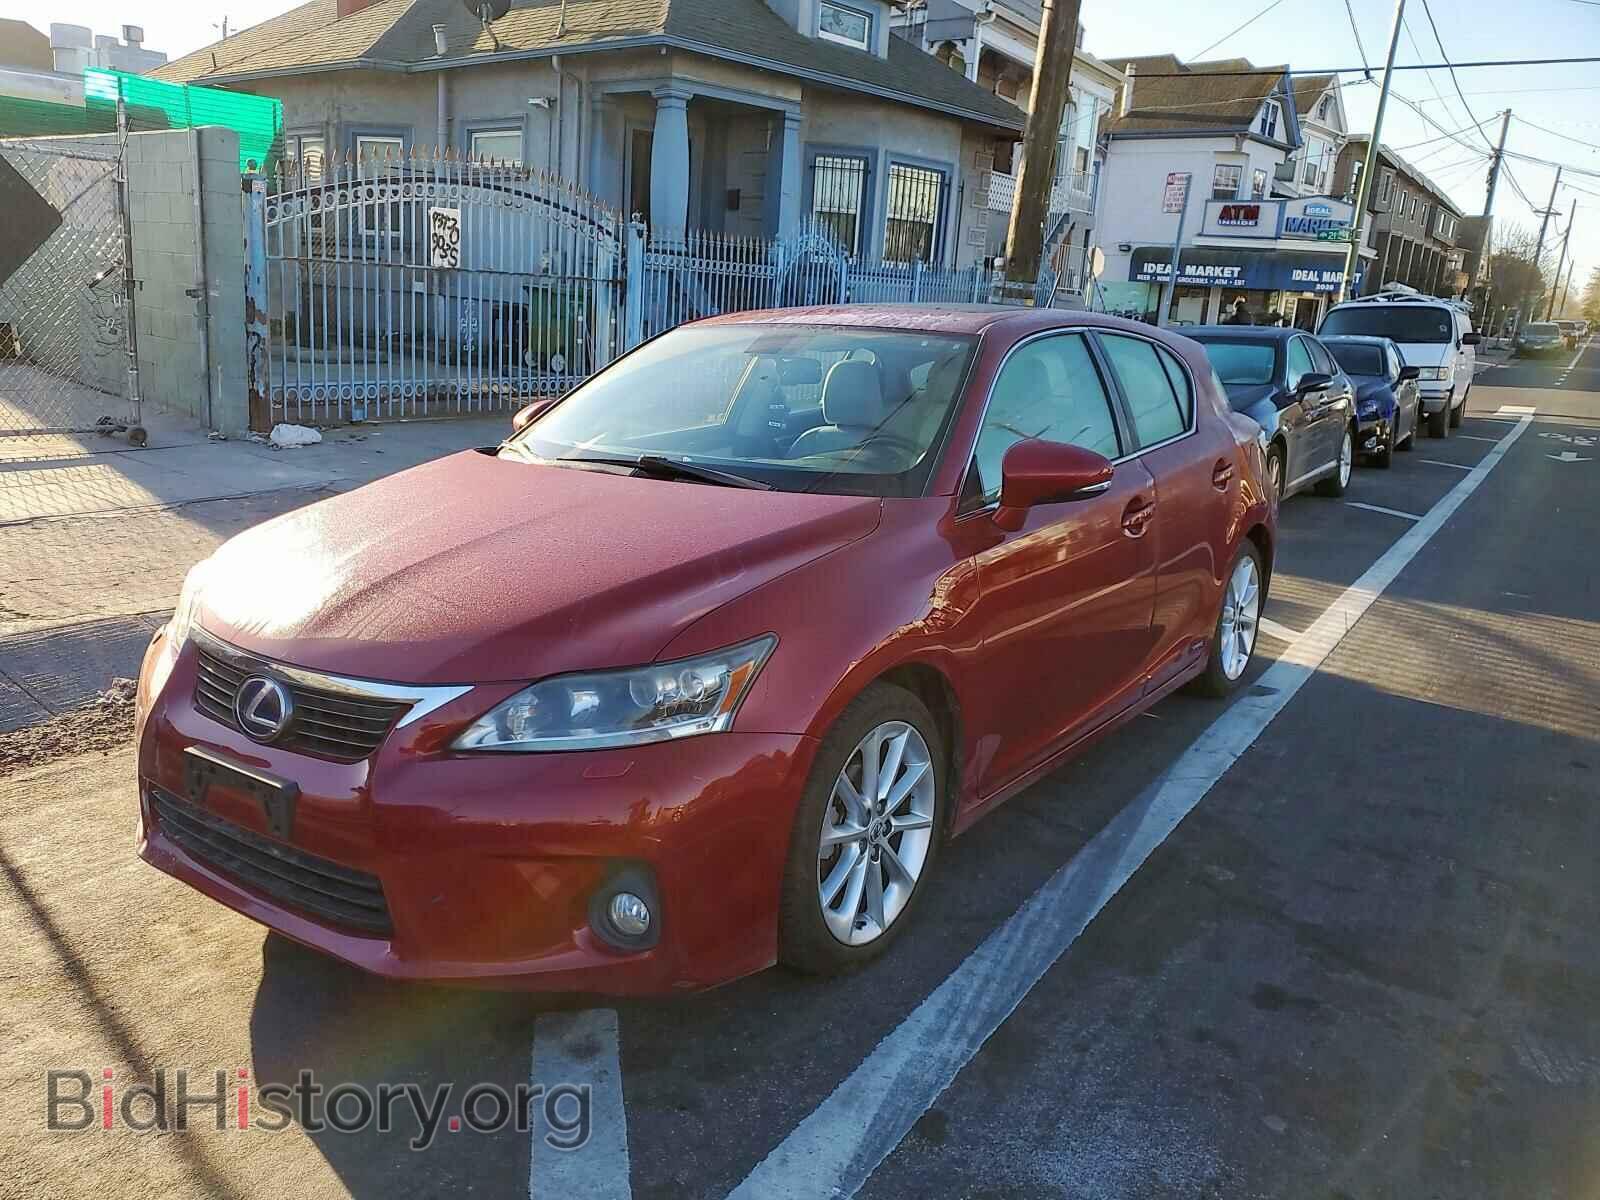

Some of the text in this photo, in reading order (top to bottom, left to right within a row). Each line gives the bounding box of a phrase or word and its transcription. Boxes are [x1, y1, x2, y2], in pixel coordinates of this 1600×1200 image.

[1219, 204, 1260, 220] ATM
[1143, 262, 1241, 278] IDEA MARKET
[1291, 269, 1320, 282] IDEAL
